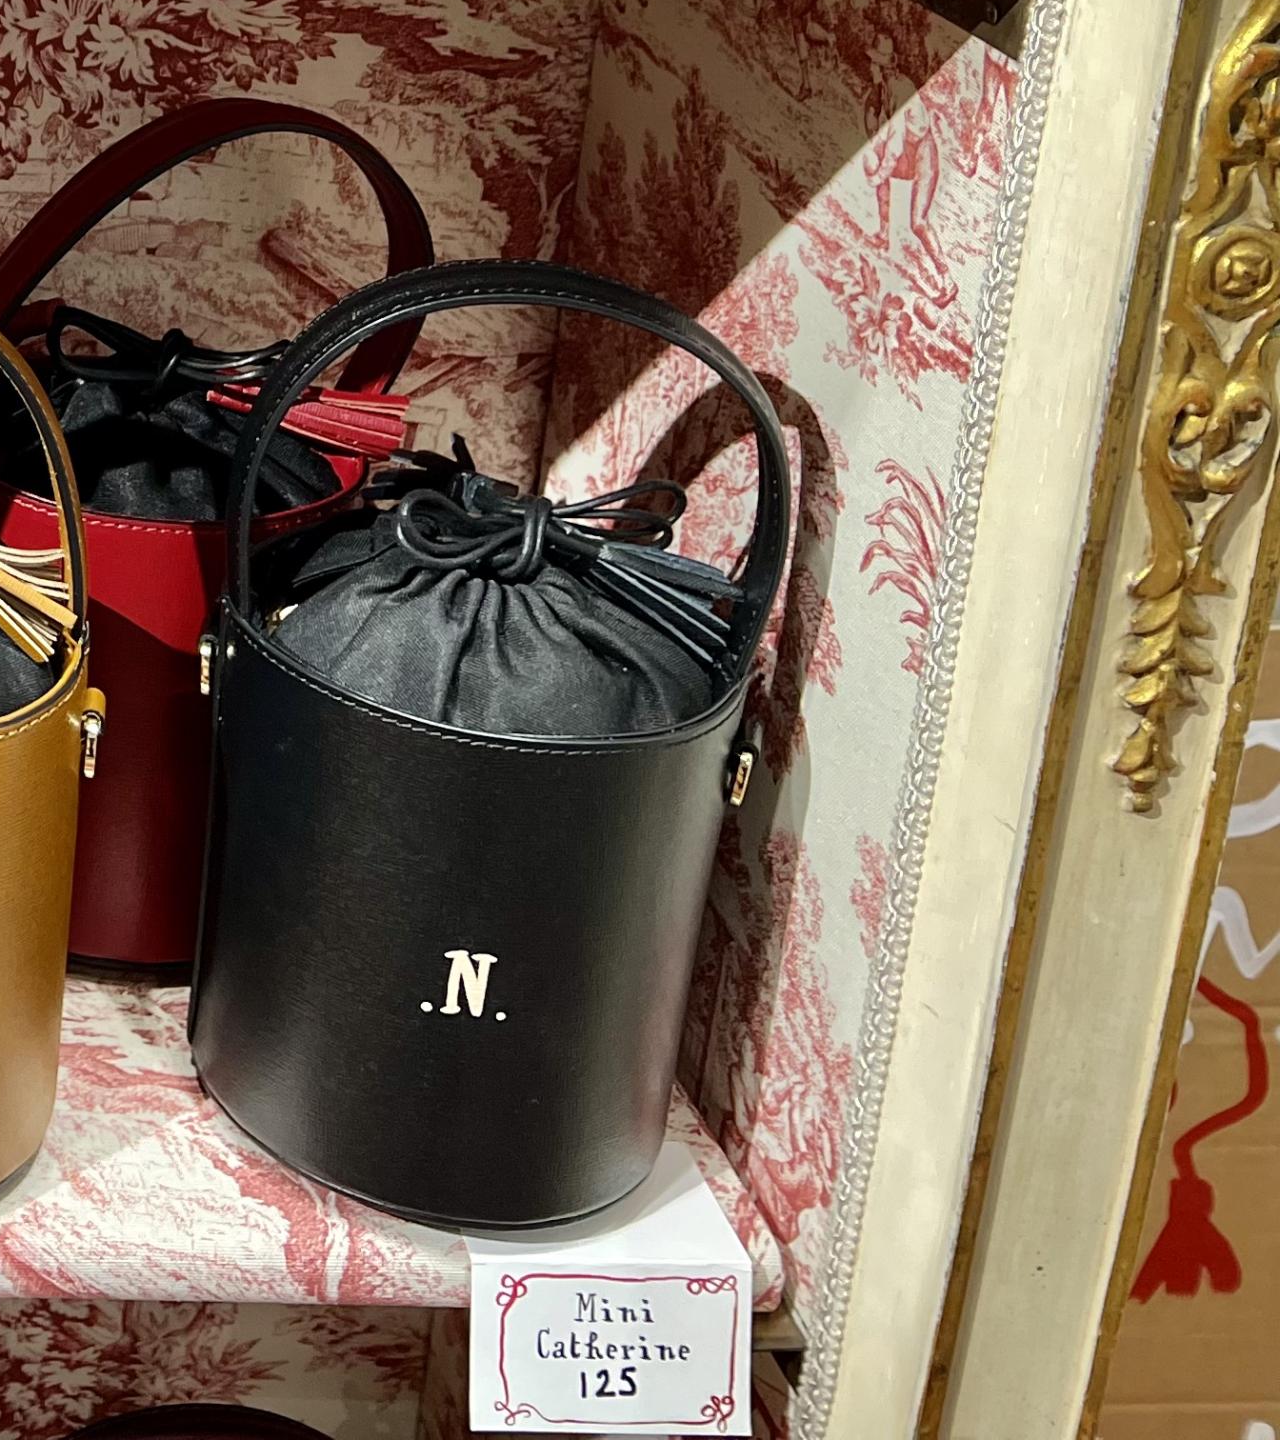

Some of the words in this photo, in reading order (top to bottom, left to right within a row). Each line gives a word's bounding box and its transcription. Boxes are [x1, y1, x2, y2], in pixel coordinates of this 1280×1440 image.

[574, 1292, 654, 1323] Mini
[536, 1328, 691, 1361] Catherine
[580, 1366, 637, 1398] 125
